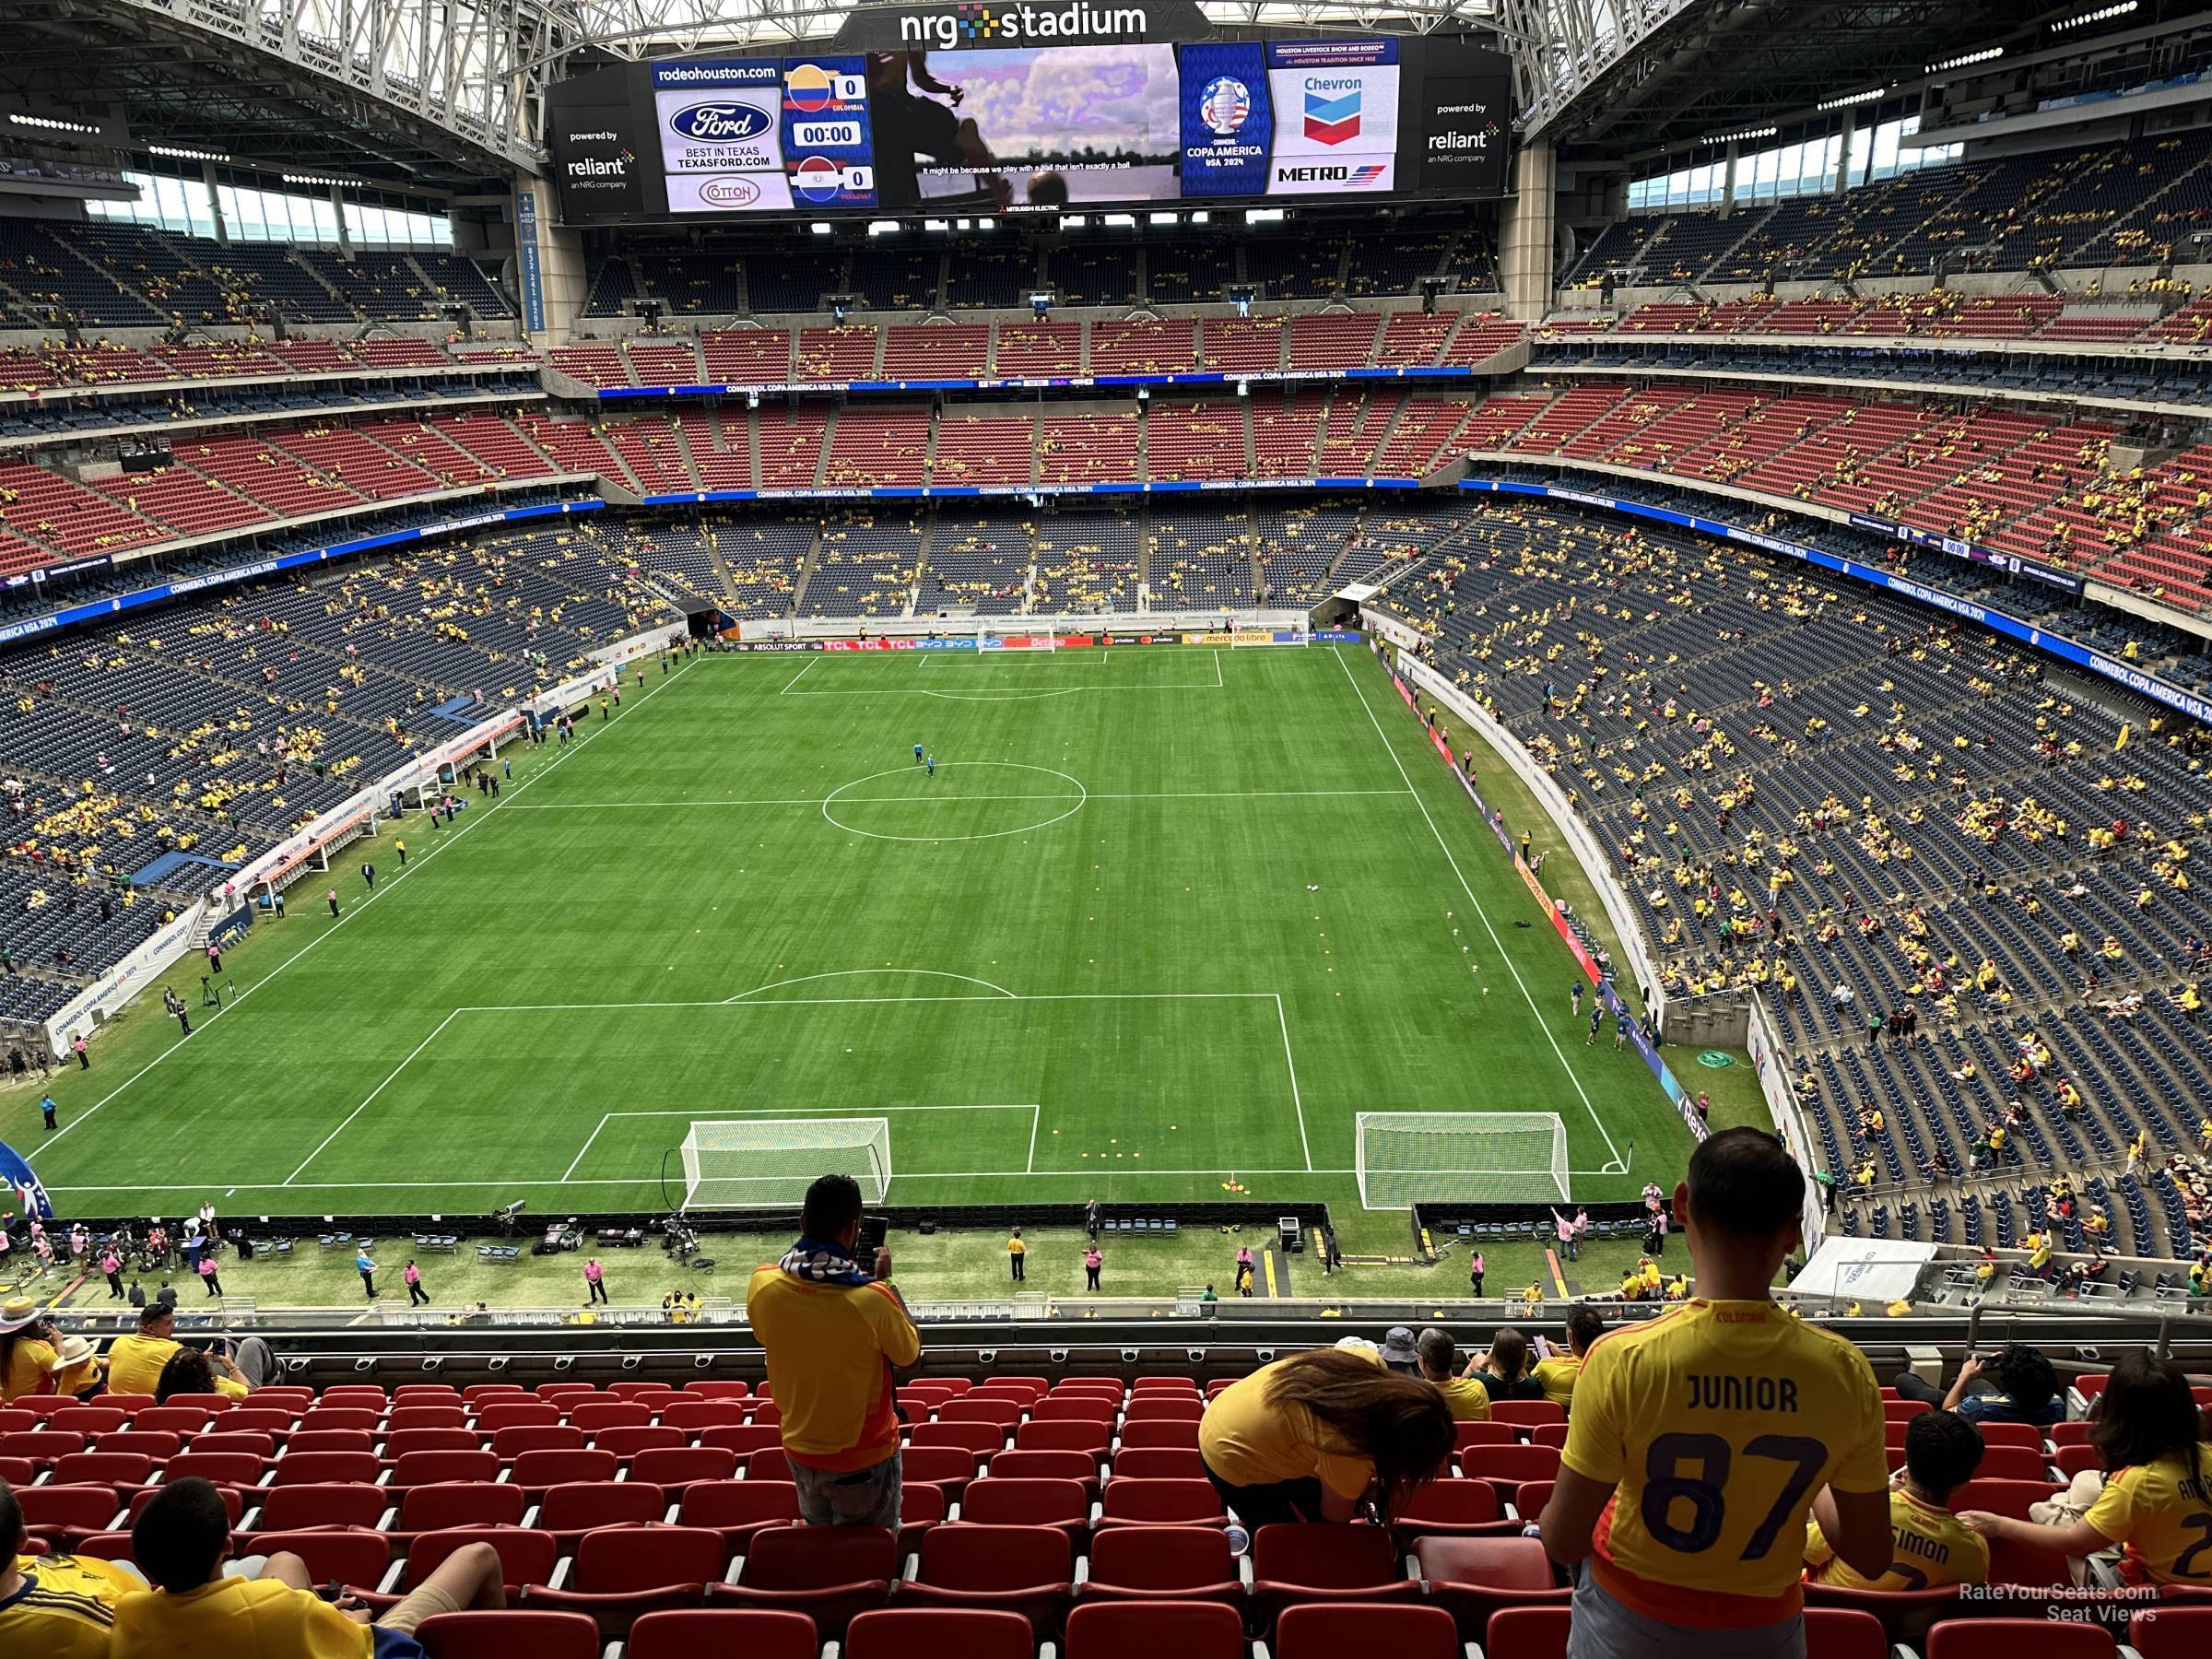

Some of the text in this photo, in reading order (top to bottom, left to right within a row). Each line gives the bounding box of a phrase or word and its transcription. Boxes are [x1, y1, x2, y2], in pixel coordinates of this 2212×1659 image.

[900, 2, 1147, 50] nrg stadium
[658, 67, 776, 81] rodeohouston.com
[845, 79, 855, 95] 0
[1304, 77, 1362, 90] Chevron
[1437, 103, 1486, 114] powered by
[691, 107, 752, 136] Ford
[570, 131, 618, 144] powered by
[804, 126, 853, 142] 00:00
[1429, 131, 1488, 149] reliant
[686, 147, 759, 158] BEST IN TEXAS
[1187, 146, 1263, 158] COPA AMERICA
[1454, 155, 1486, 163] company
[568, 159, 625, 176] reliant
[677, 157, 771, 168] TEXASFORD.COM
[929, 168, 948, 176] might
[1003, 166, 1018, 175] play
[1055, 163, 1068, 171] that
[1069, 162, 1084, 171] isn't
[1085, 162, 1110, 171] exactly
[1206, 158, 1244, 167] USA 2024
[853, 171, 864, 186] 0
[1277, 166, 1347, 182] METRO
[580, 181, 595, 189] NRG
[595, 181, 627, 190] company
[1314, 371, 1328, 379] USA
[170, 561, 277, 594] CONMEBOL COPA AMERICA USA 2024
[1888, 577, 1985, 621] CONMEBOL COPA AMERICA USA 2024
[24, 621, 40, 635] USA
[40, 616, 57, 629] 2024
[754, 642, 806, 651] ABSOLUT SPORT
[825, 641, 850, 651] TCL
[859, 641, 882, 650] TCL
[888, 641, 914, 649] TCL
[2089, 655, 2129, 683] CONMEBOL
[2129, 673, 2149, 692] COPA
[2149, 682, 2186, 709] AMERICA
[2187, 699, 2203, 718] USA
[153, 935, 177, 955] CONMEBOL
[55, 966, 136, 1035] CONMEBOL COPA AMERICA USA 2024
[1687, 1375, 1797, 1412] JUNIOR
[1641, 1432, 1829, 1561] 87
